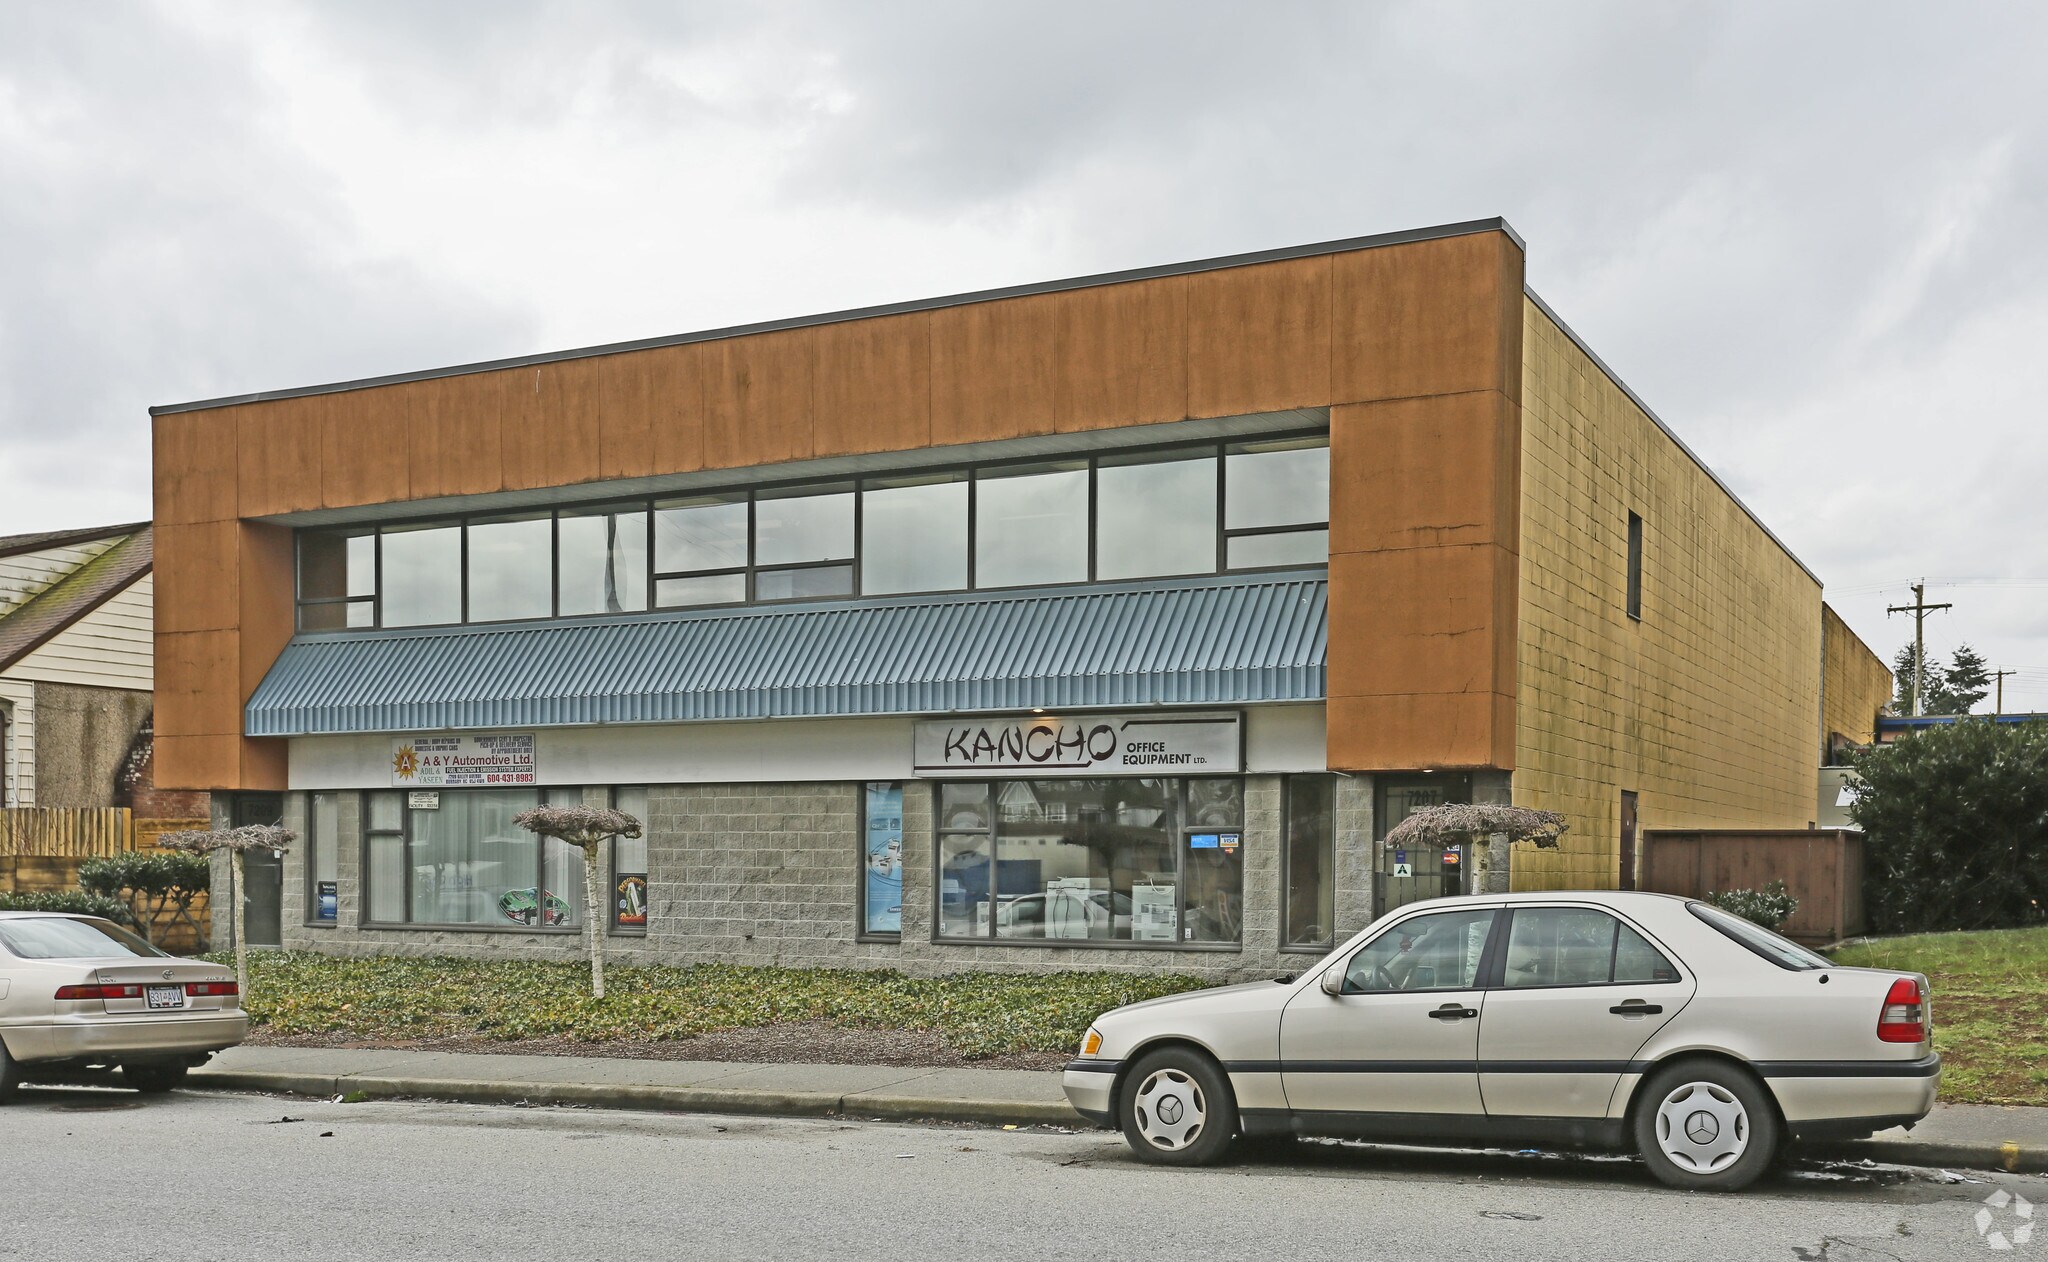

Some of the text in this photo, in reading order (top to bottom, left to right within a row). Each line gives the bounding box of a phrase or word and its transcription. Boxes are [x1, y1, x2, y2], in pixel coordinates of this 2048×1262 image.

[945, 724, 1117, 763] KANCHO
[1126, 742, 1166, 753] OFFICE
[423, 753, 533, 766] A & Y Automotive Ltd.
[1122, 754, 1192, 766] EQUIPMENT
[487, 773, 533, 783] 604-431-8983
